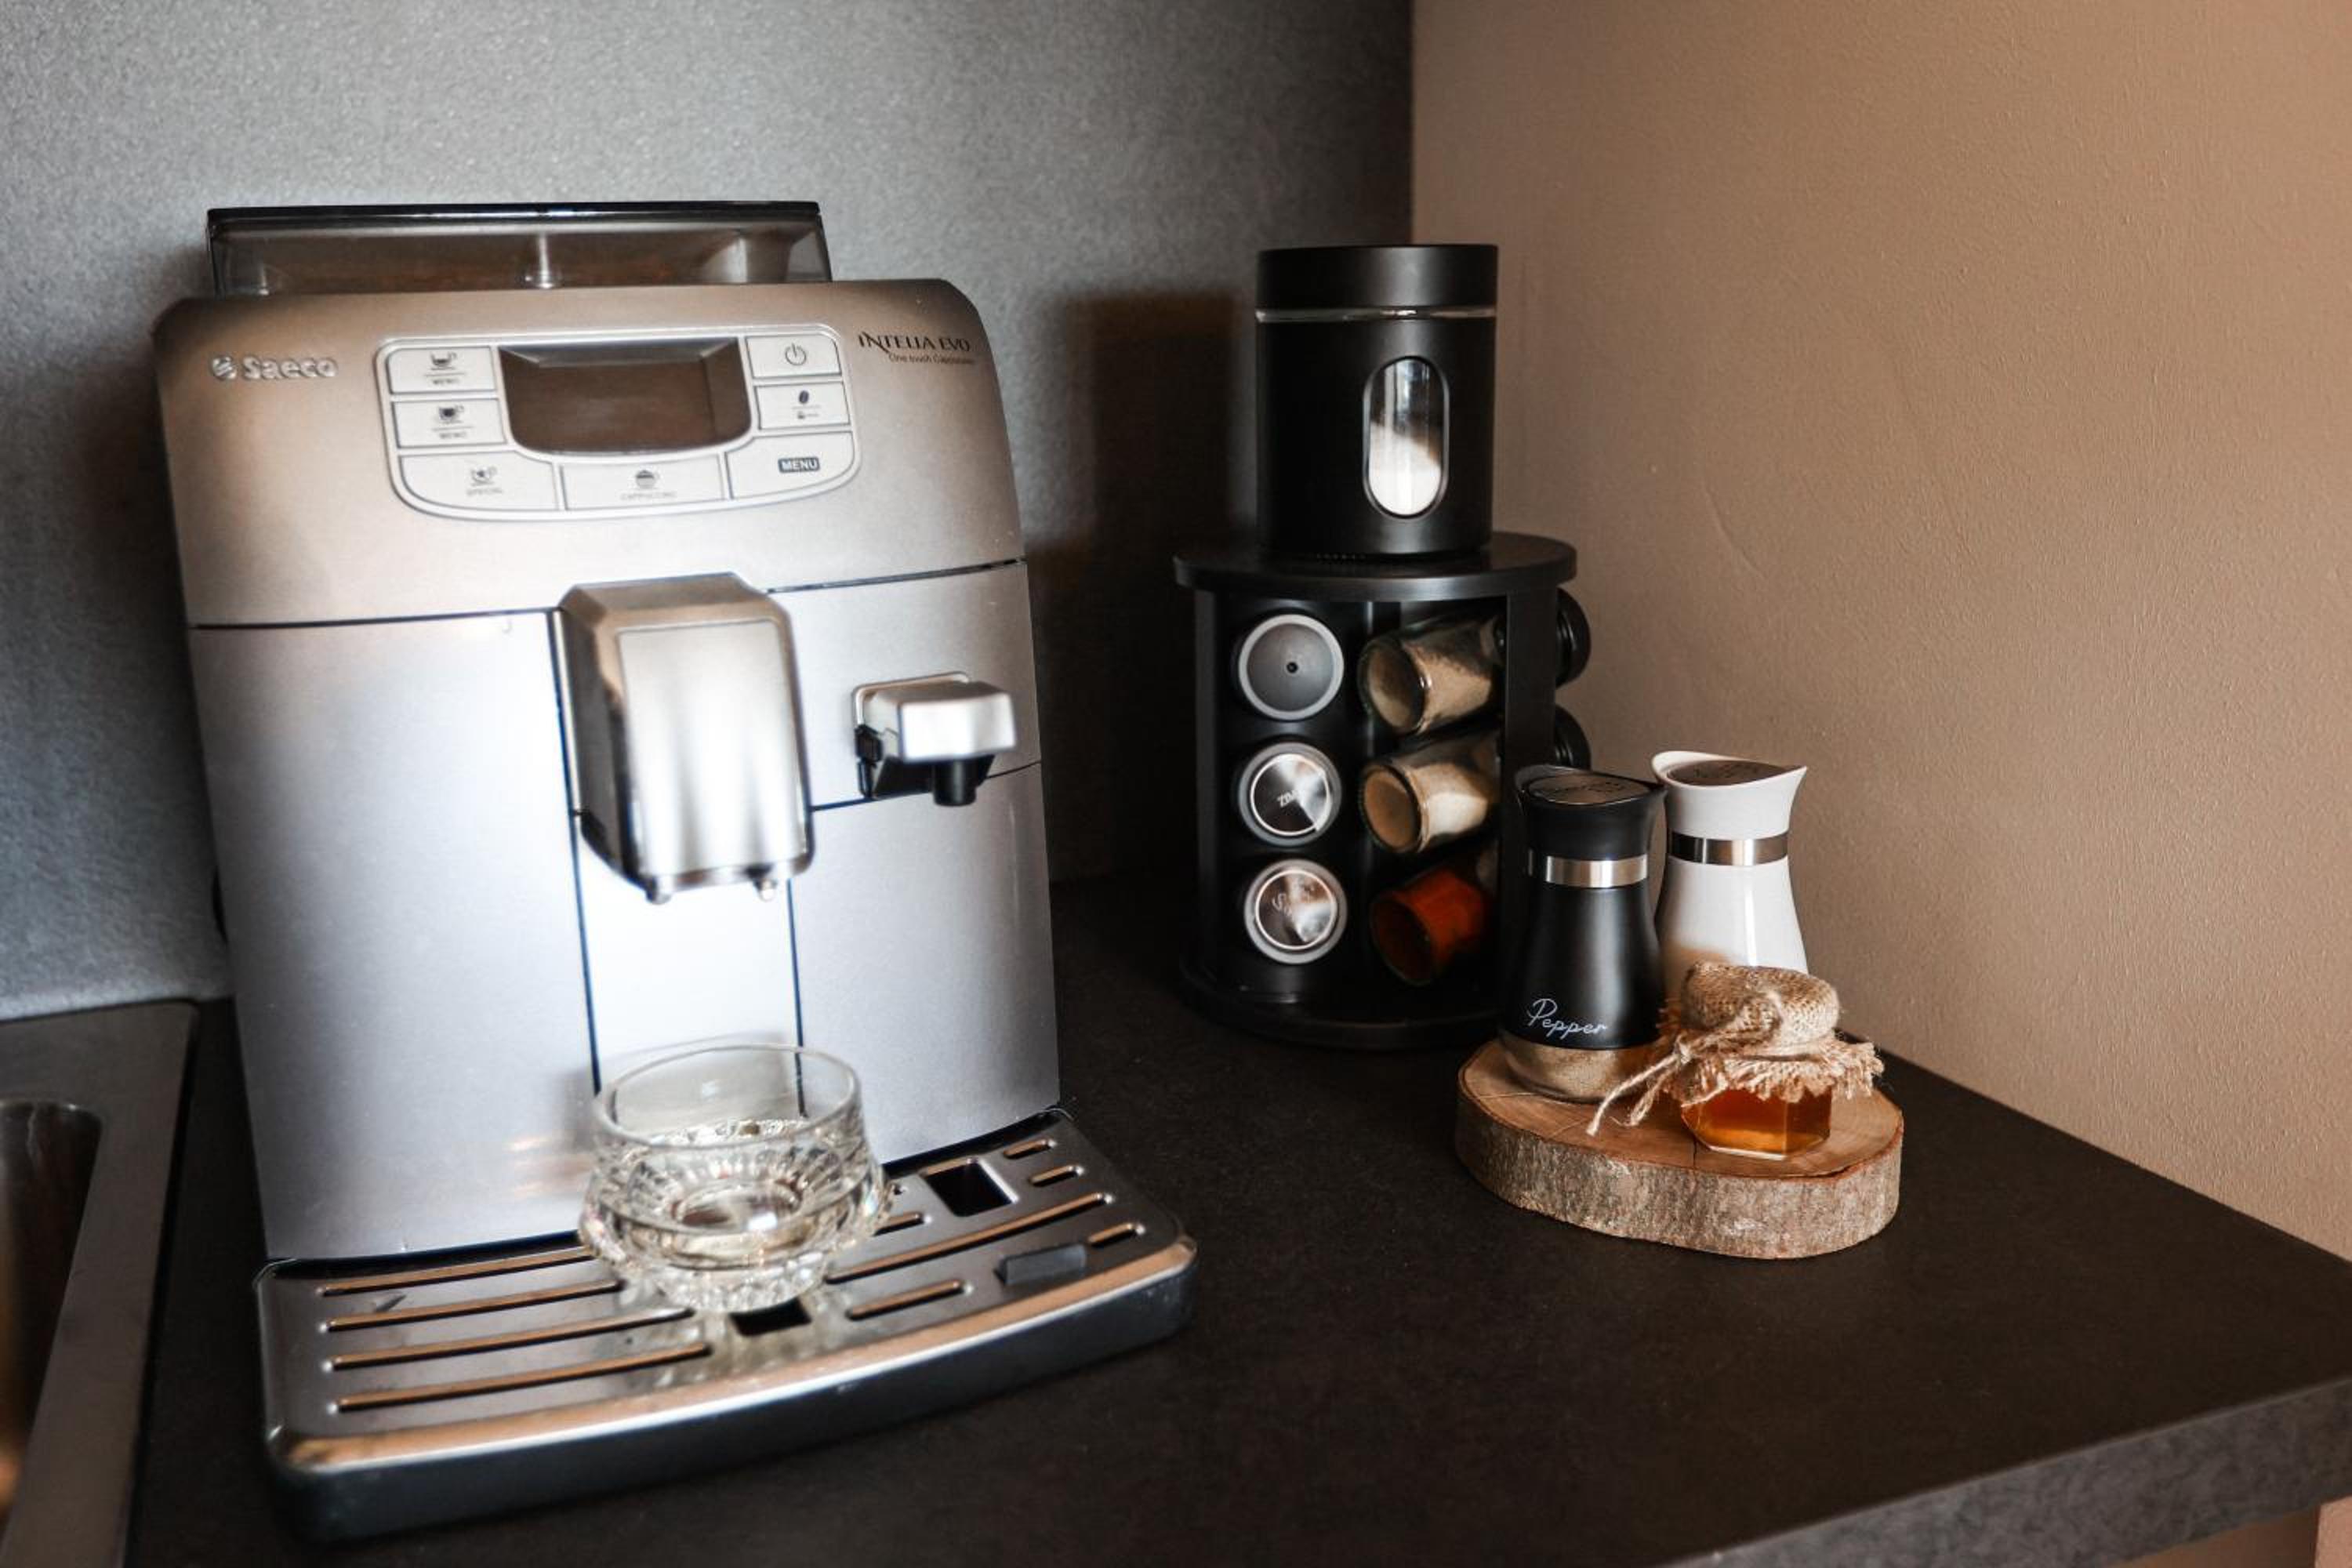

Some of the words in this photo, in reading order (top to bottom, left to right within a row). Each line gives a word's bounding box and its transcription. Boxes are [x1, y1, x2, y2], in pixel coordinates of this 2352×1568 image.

[938, 337, 971, 351] EVO
[241, 354, 338, 380] Saeco
[780, 459, 818, 471] MENU
[1526, 998, 1606, 1040] Pepper
